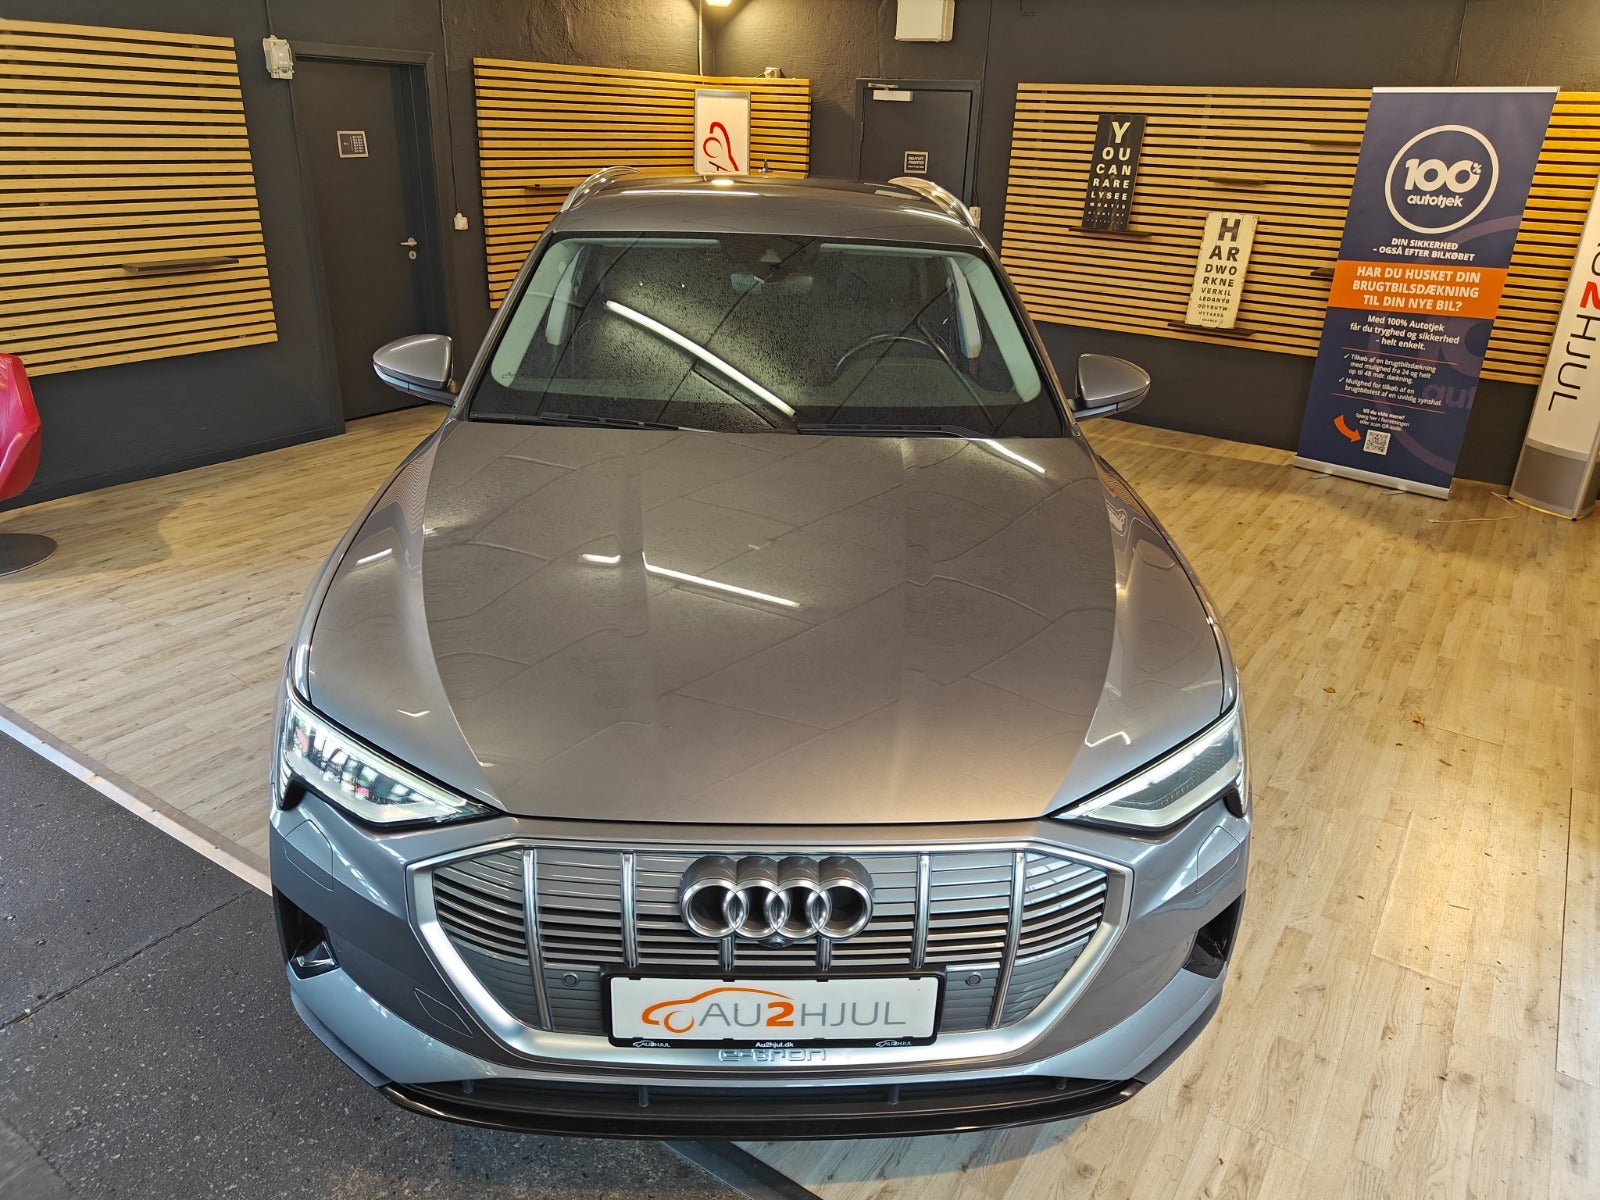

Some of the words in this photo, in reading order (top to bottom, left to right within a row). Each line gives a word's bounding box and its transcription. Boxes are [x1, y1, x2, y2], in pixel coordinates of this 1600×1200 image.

[1112, 122, 1131, 144] Y
[1102, 147, 1131, 161] OU
[1096, 164, 1132, 176] CAN
[1404, 158, 1482, 193] 100%
[1092, 178, 1130, 188] RARE
[1091, 191, 1128, 200] LYSEE
[1407, 194, 1464, 208] autotjek
[1218, 218, 1241, 242] H
[1392, 238, 1408, 246] DIN
[1410, 240, 1458, 250] SIKKERHED
[1209, 245, 1240, 262] AR
[1379, 246, 1402, 255] OGSÅ
[1404, 248, 1430, 258] EFTER
[1432, 250, 1475, 262] BILKØBET
[1204, 264, 1238, 276] DWO
[1356, 266, 1382, 278] HAR
[1384, 268, 1402, 279] DU
[1405, 269, 1453, 282] HUSKET
[1456, 272, 1481, 283] DIN
[1202, 276, 1234, 287] RKNE
[1352, 280, 1480, 298] BRUGTBILSDÆKNING
[1201, 288, 1231, 296] VERKIL
[1363, 295, 1380, 306] TIL
[1383, 296, 1406, 307] DIN
[1408, 298, 1432, 310] NYE
[1436, 300, 1462, 312] BIL?
[1368, 315, 1386, 324] Med
[1388, 318, 1408, 326] 100%
[1409, 320, 1445, 332] Autotjek
[1350, 322, 1361, 330] får
[1374, 326, 1406, 337] tryghed
[1406, 332, 1417, 340] og
[1418, 332, 1460, 344] sikkerhed
[1382, 338, 1396, 346] helt
[1398, 340, 1426, 350] enkelt.
[1351, 354, 1368, 362] Tilkøb
[1384, 358, 1437, 374] brugtbilsdækning
[1364, 364, 1391, 373] mulighed
[1392, 366, 1400, 374] fra
[1402, 368, 1410, 376] 24
[1345, 378, 1372, 388] Mulighed
[1372, 380, 1382, 388] for
[1382, 383, 1399, 391] tilkøb
[698, 1000, 906, 1028] AU2HJUL
